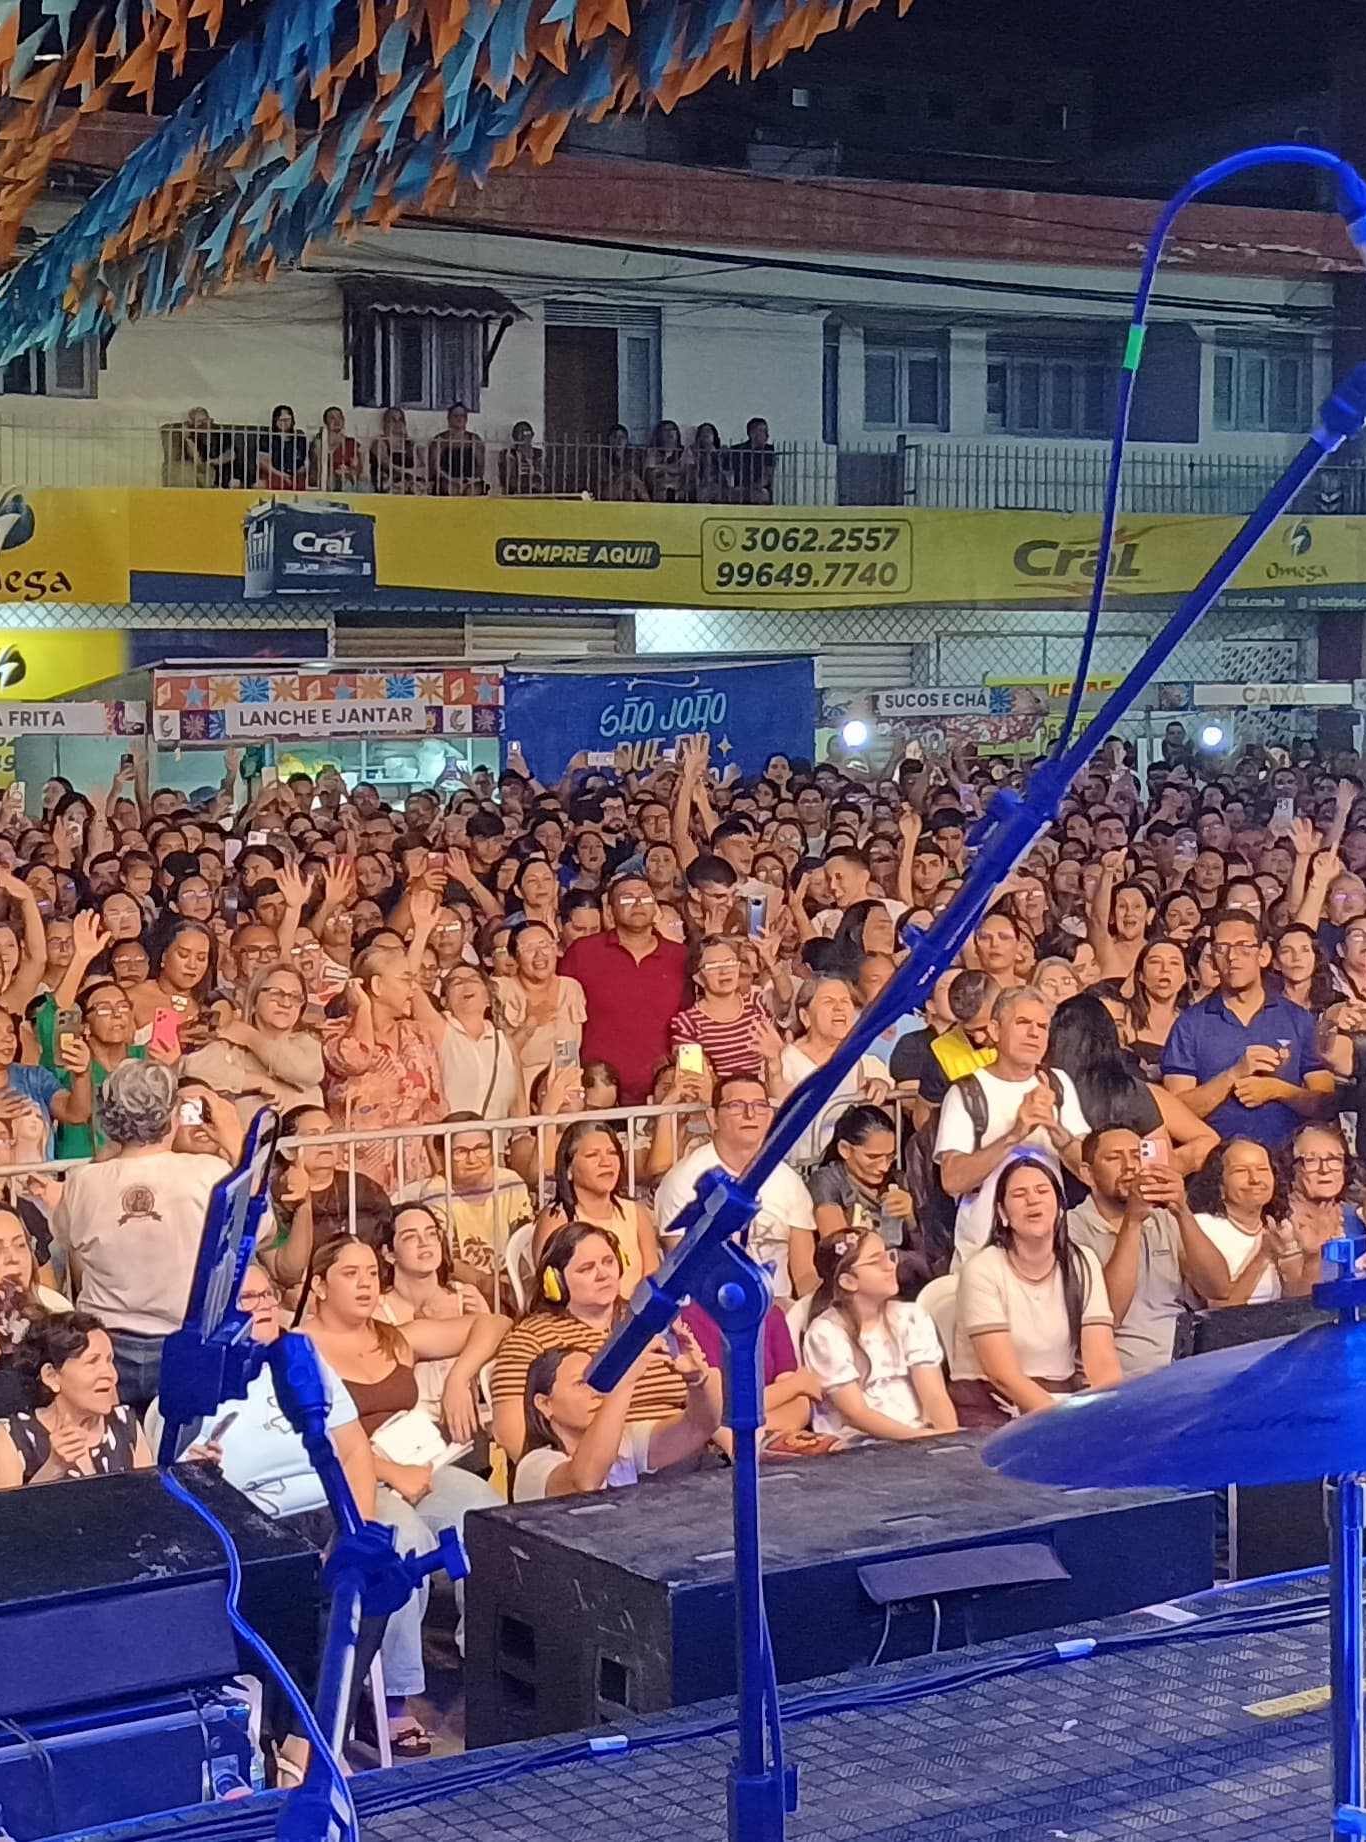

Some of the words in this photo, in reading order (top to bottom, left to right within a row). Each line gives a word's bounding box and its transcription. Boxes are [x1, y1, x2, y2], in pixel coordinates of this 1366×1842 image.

[292, 531, 354, 555] Cral
[741, 526, 900, 553] 3062.2557
[501, 543, 590, 564] COMPRE
[1013, 539, 1141, 577] Cral
[715, 561, 899, 588] 99649.7740
[1266, 561, 1329, 582] Omega
[885, 693, 939, 709] SUCOS
[942, 693, 951, 708] E
[954, 690, 988, 708] CHÁ
[1242, 685, 1307, 705] CAIXA
[8, 710, 66, 727] FRITA
[239, 708, 317, 727] LANCHE
[322, 708, 332, 724] E
[336, 706, 413, 724] JANTAR
[599, 696, 655, 737] SÃO
[659, 688, 727, 732] JOÃO
